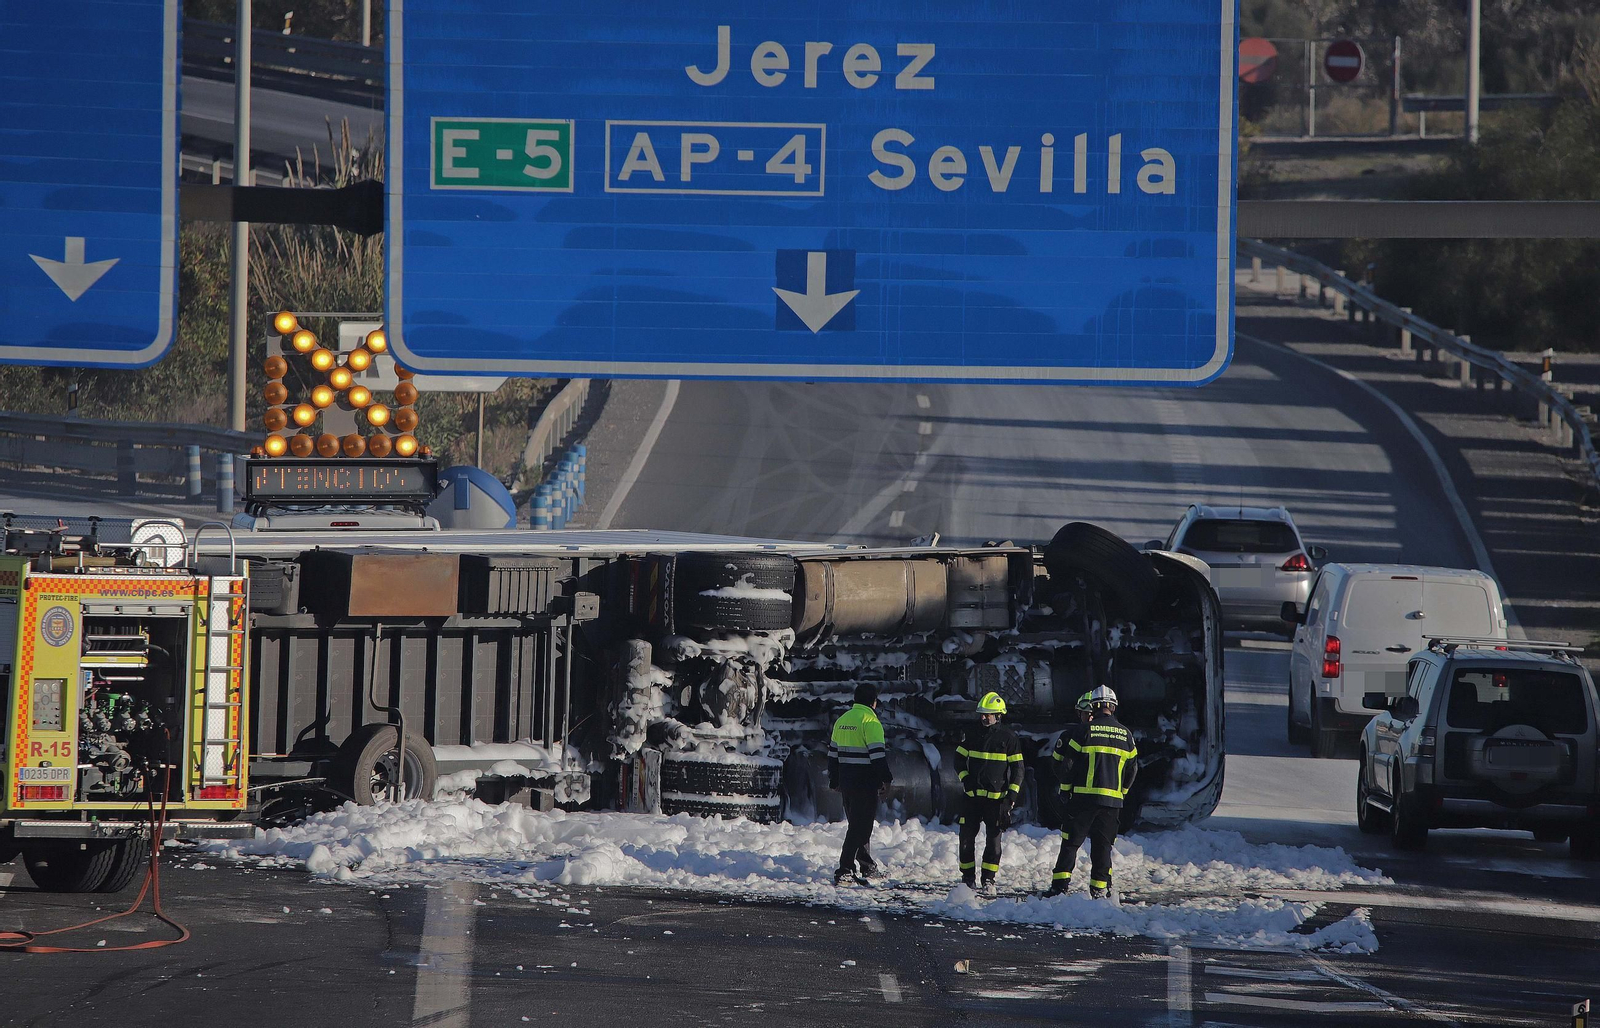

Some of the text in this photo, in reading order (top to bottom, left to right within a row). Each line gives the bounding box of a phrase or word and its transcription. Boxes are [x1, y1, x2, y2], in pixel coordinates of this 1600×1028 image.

[685, 25, 936, 91] Jerez
[441, 128, 563, 180] E-5
[617, 131, 812, 184] AP-4
[868, 127, 1177, 196] Sevilla
[39, 594, 78, 602] PROTEC-FIRE
[100, 588, 174, 599] www.cbpc.es
[1090, 725, 1127, 736] BOMBEROS
[31, 741, 72, 758] R-15
[24, 769, 69, 780] 0235 DPR
